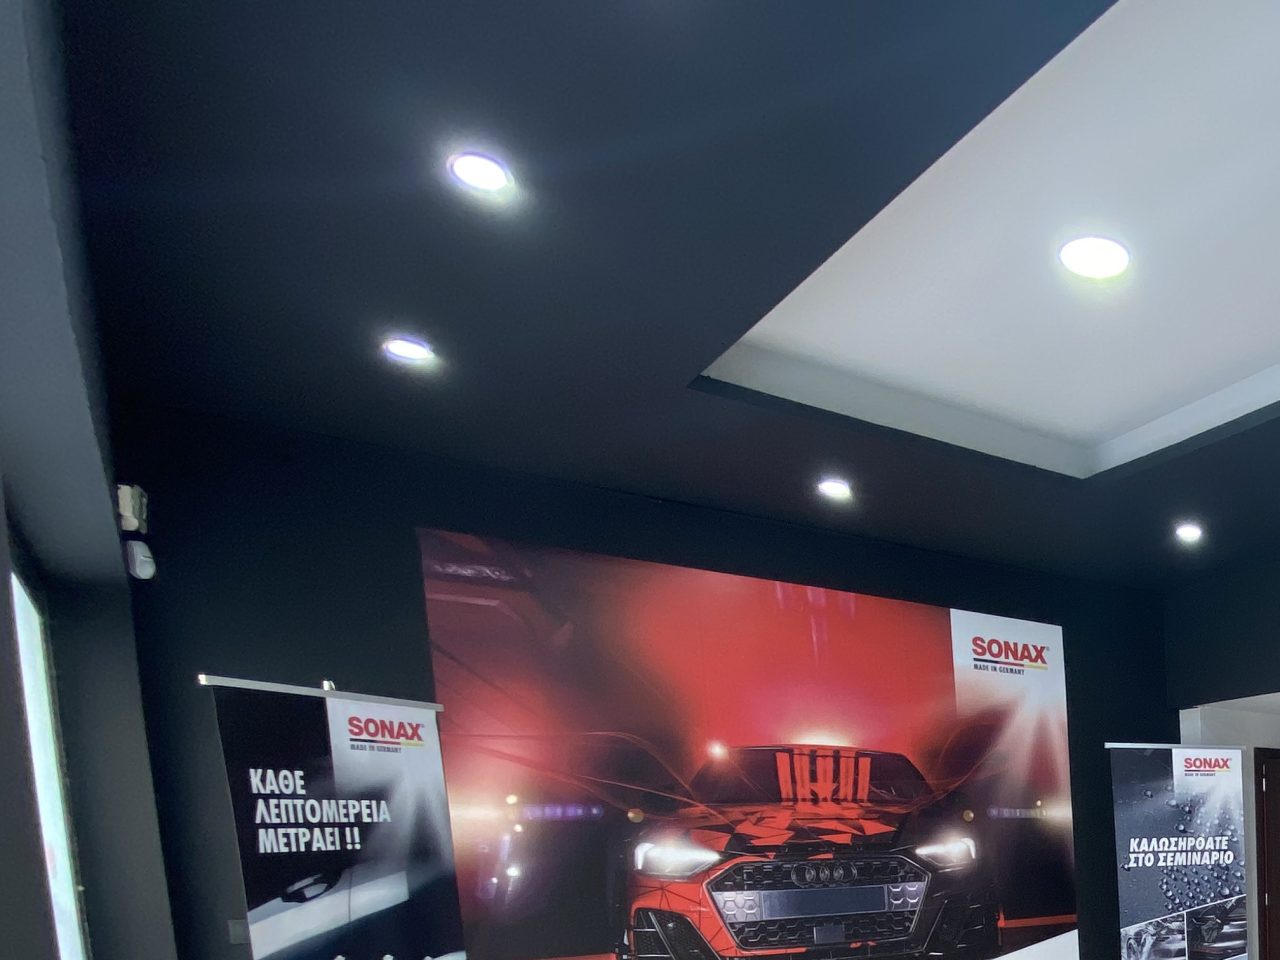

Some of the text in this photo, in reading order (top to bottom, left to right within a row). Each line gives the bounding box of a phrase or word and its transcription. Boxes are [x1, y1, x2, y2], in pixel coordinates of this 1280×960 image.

[972, 636, 1048, 665] SONAX
[973, 664, 989, 672] MADE
[999, 666, 1025, 676] GERMANY
[347, 716, 424, 742] SONAX
[1184, 757, 1230, 769] SONAX
[249, 768, 306, 796] ΚΑΘΕ
[255, 799, 392, 825] ΛΕΠΤΟΜΕΡΕΙΑ
[258, 827, 341, 854] ΜΕΤΡΑΕΙ
[1128, 850, 1234, 867] ΣΤΟ ΣΕΜΙΝΑΡΙΟ
